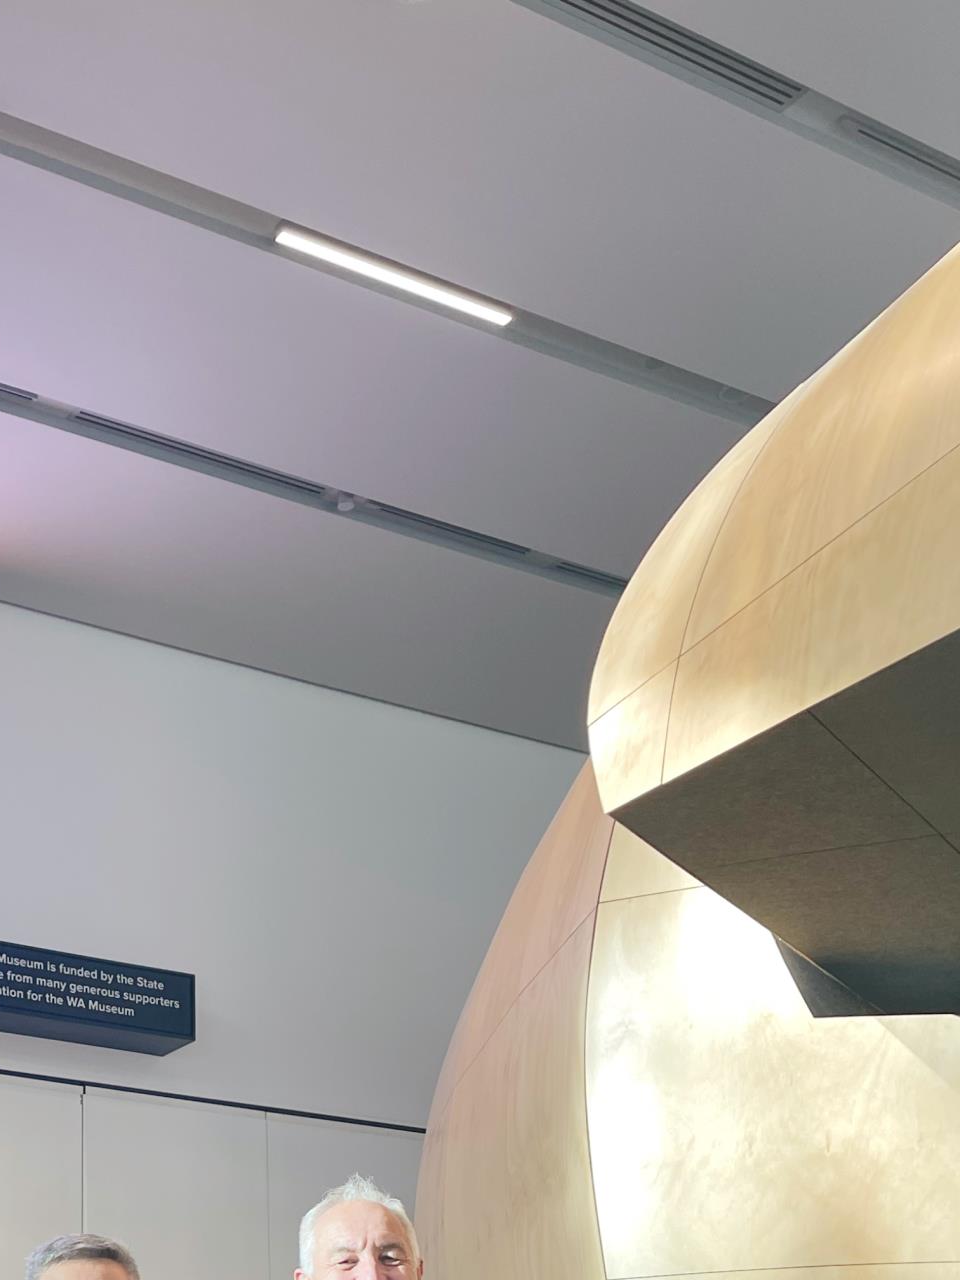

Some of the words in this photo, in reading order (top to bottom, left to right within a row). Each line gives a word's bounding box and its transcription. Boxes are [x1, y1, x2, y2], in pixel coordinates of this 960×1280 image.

[7, 972, 33, 984] from
[36, 977, 67, 992] many
[69, 982, 120, 999] generous
[123, 991, 180, 1009] supporters
[47, 961, 56, 972] is
[59, 964, 98, 980] funded
[100, 972, 114, 984] by
[117, 974, 134, 986] the
[137, 977, 165, 991] State
[27, 989, 43, 1002] for
[46, 993, 64, 1005] the
[66, 996, 86, 1009] WA
[89, 1000, 135, 1016] Museum
